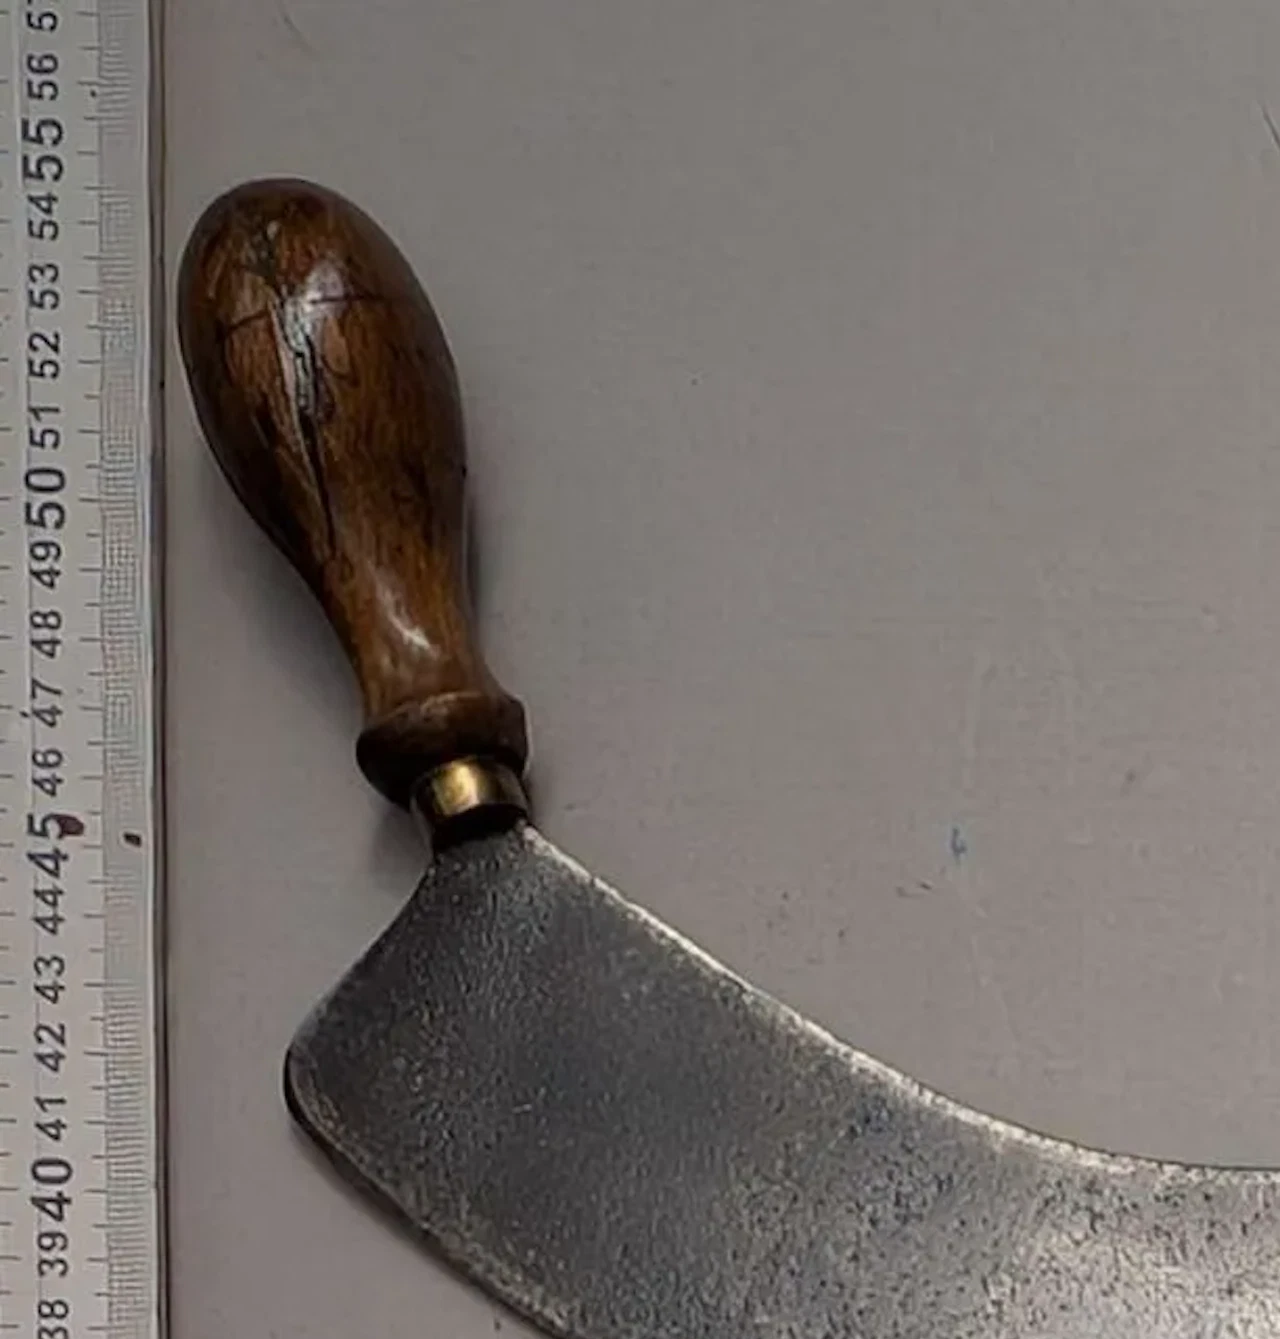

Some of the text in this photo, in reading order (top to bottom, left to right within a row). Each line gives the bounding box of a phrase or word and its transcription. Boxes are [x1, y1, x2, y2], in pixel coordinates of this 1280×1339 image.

[26, 0, 58, 33] 5
[26, 53, 59, 102] 56
[20, 117, 65, 183] 55
[26, 191, 60, 242] 54
[26, 262, 61, 311] 53
[26, 331, 61, 380] 52
[26, 403, 61, 451] 51
[23, 466, 67, 531] 50
[28, 540, 63, 591] 49
[28, 609, 63, 660] 48
[29, 678, 64, 729] 47
[30, 747, 65, 798] 46
[25, 812, 70, 880] 45
[30, 885, 66, 937] 44
[32, 954, 66, 1005] 43
[33, 1023, 67, 1074] 42
[33, 1095, 68, 1143] 41
[29, 1157, 74, 1223] 40
[36, 1230, 70, 1279] 39
